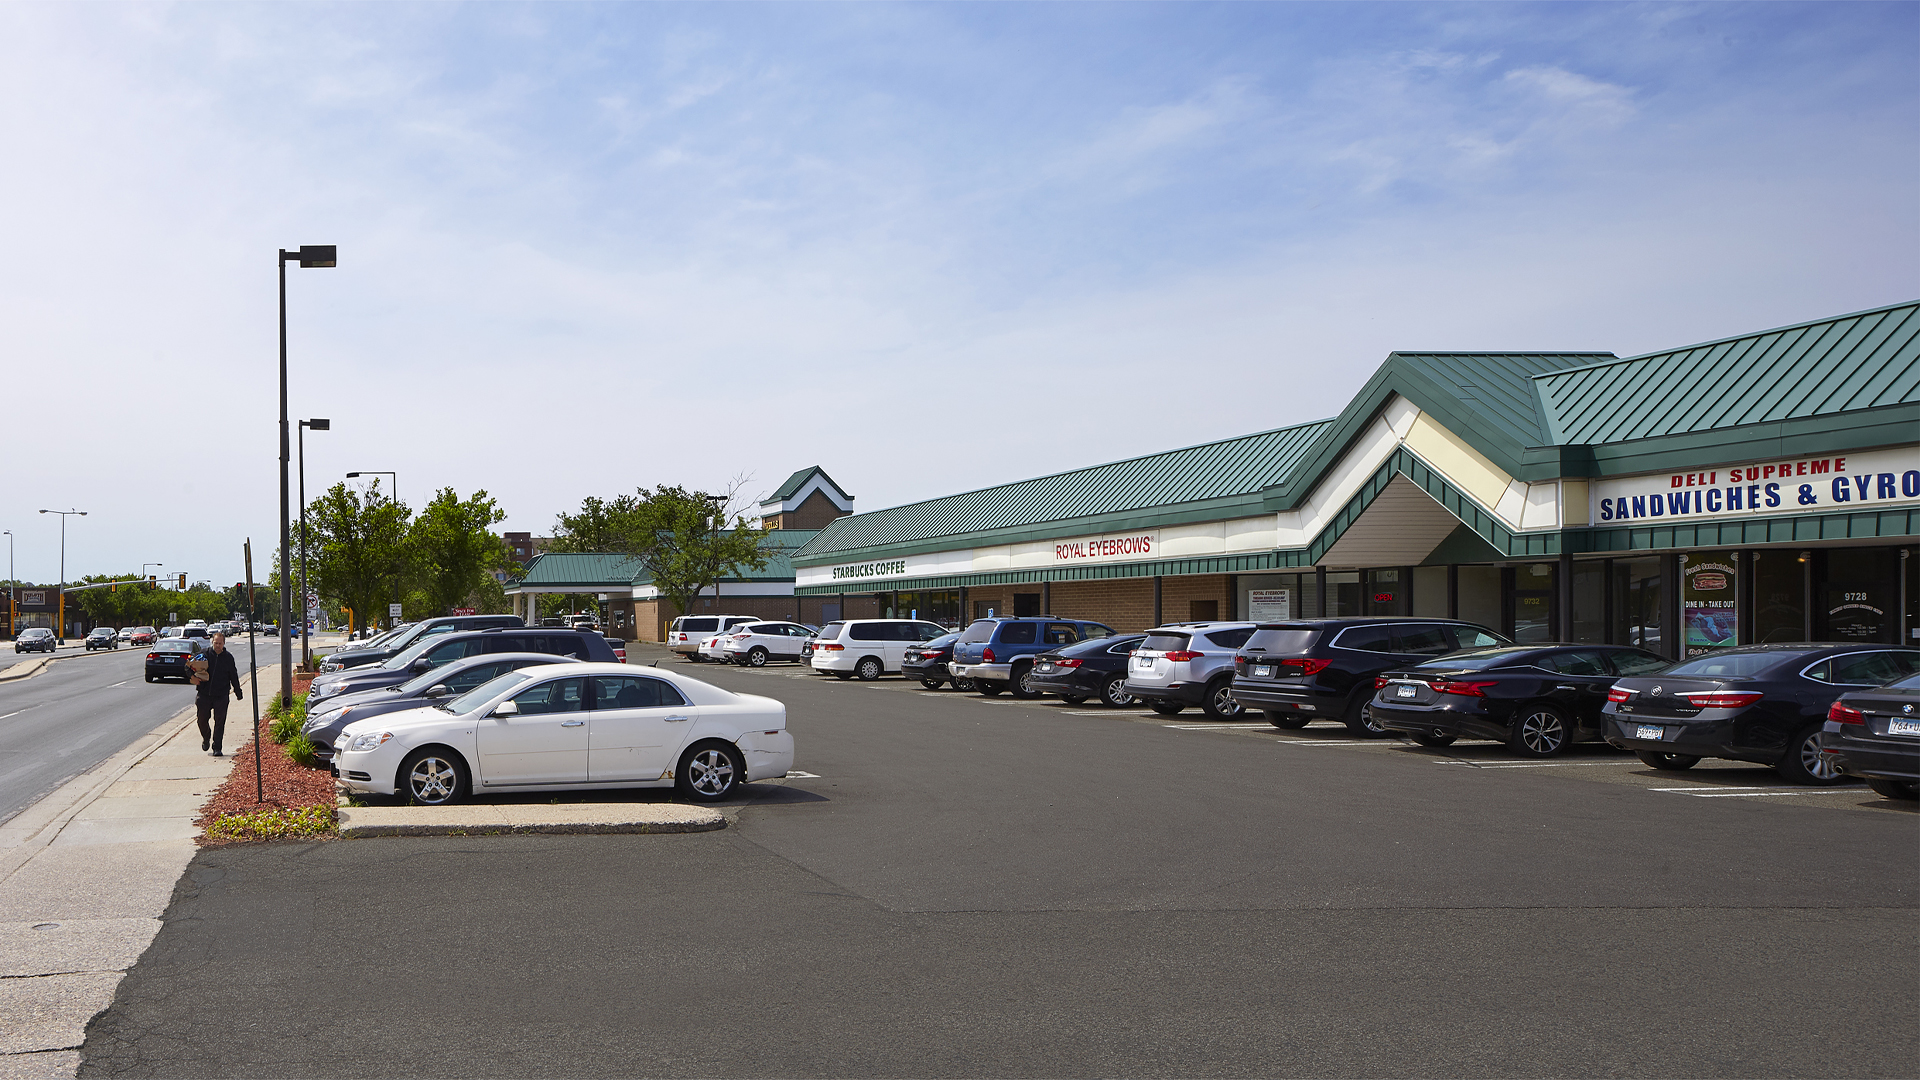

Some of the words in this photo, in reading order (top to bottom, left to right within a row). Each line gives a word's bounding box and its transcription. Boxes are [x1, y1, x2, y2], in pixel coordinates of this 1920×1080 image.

[1670, 471, 1717, 488] DELI
[1729, 457, 1846, 483] SUPREME
[1600, 482, 1781, 521] SANDWICHES
[1797, 483, 1818, 506] &
[1056, 542, 1086, 560] ROYAL
[832, 563, 874, 580] STARBUCKS
[875, 560, 906, 576] COFFEE
[1701, 562, 1735, 575] Sandwiches
[1374, 593, 1393, 602] OPEN
[1523, 597, 1540, 605] 9732
[1844, 592, 1868, 601] 9728
[1685, 600, 1698, 608] DINE
[1698, 600, 1705, 608] IN
[1708, 600, 1723, 608] TAKE
[1723, 600, 1735, 608] OUT
